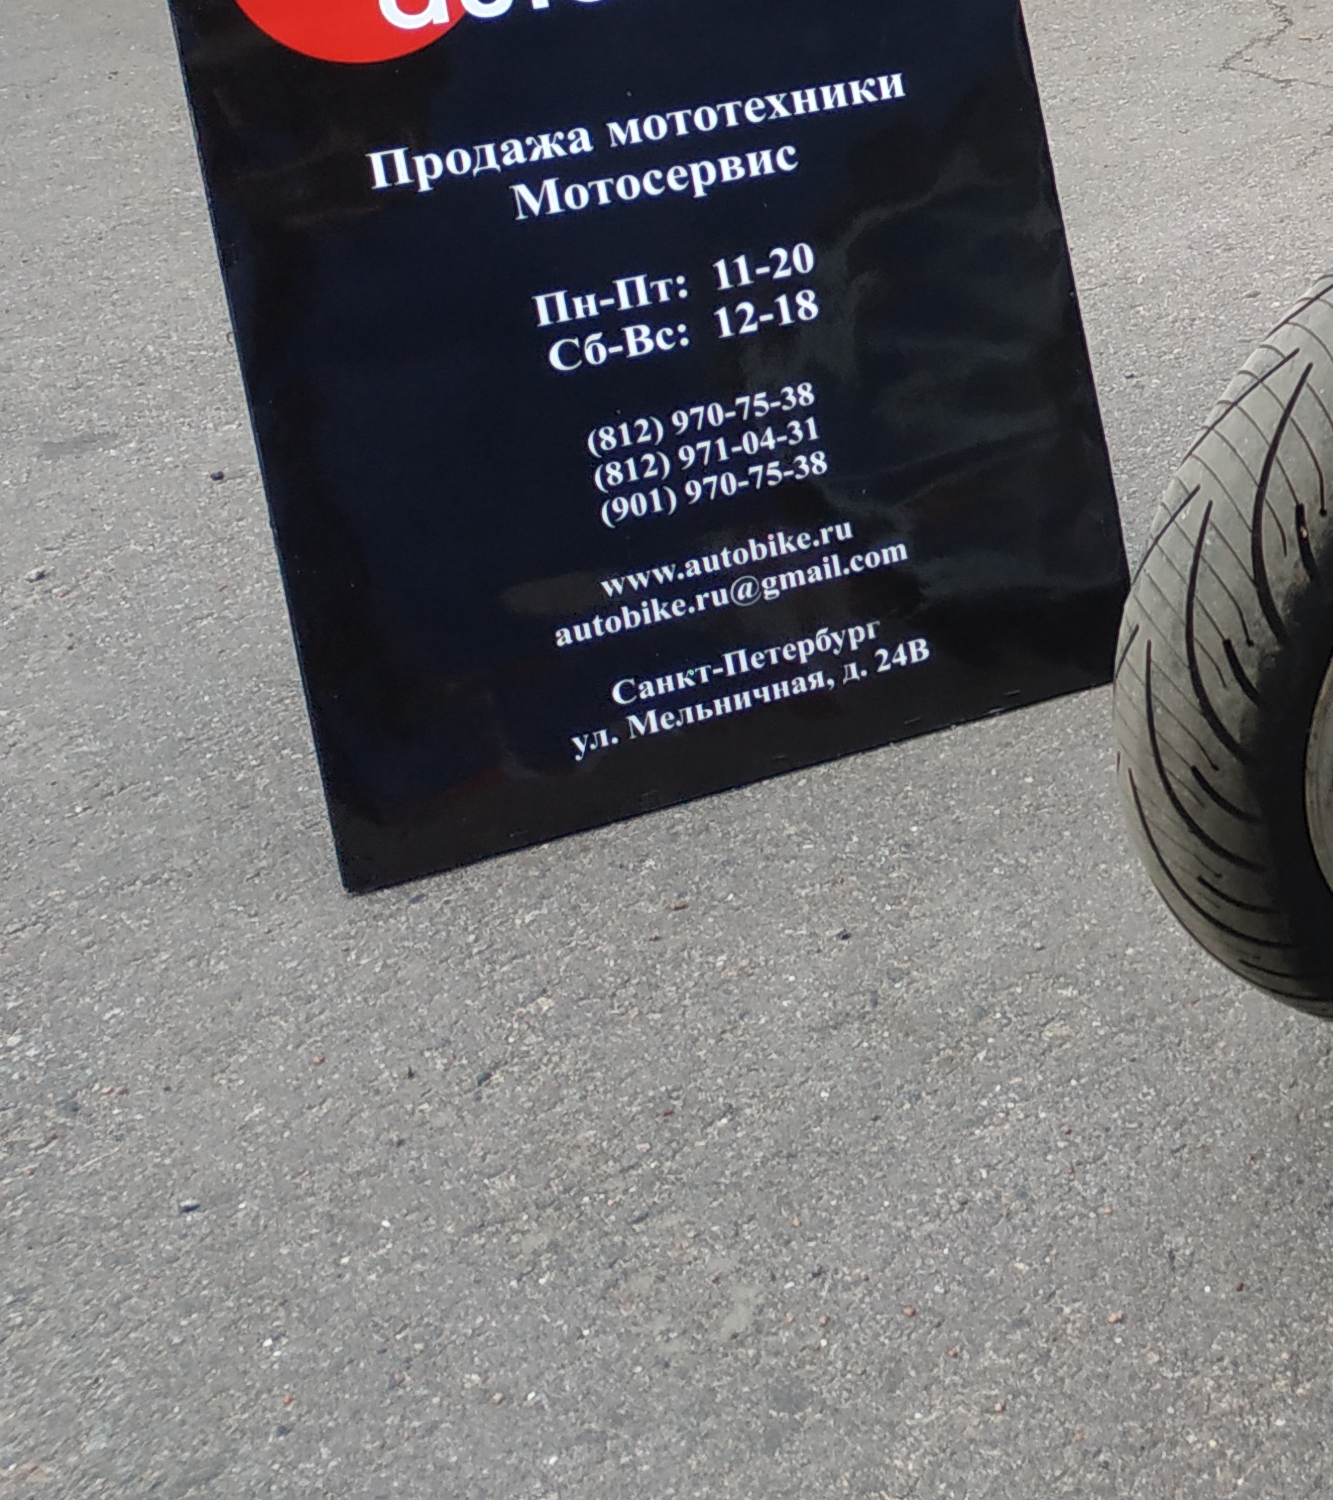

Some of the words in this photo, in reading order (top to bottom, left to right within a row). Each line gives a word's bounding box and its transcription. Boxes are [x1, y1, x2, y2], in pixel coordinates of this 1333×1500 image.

[365, 127, 594, 191] Продажа
[605, 72, 906, 148] мототехники
[509, 145, 799, 221] Мотосервис
[532, 274, 688, 327] Пн-Пт:
[712, 242, 815, 291] 11-20
[548, 323, 690, 371] Сб-Вс:
[713, 289, 819, 339] 12-18
[587, 416, 664, 458] (812)
[671, 382, 815, 435] 970-75-38
[594, 451, 671, 494] (812)
[677, 416, 819, 470] 971-04-31
[601, 486, 677, 528] (901)
[684, 450, 828, 505] 970-75-38
[555, 543, 909, 647] autobike.ru@gmail.com
[600, 521, 853, 597] www.autobike.ru
[571, 729, 619, 762] ул.
[625, 670, 835, 740] Мельничная,
[841, 661, 869, 686] д.
[876, 638, 930, 673] 24В
[611, 620, 880, 705] Санкт-Петербург
